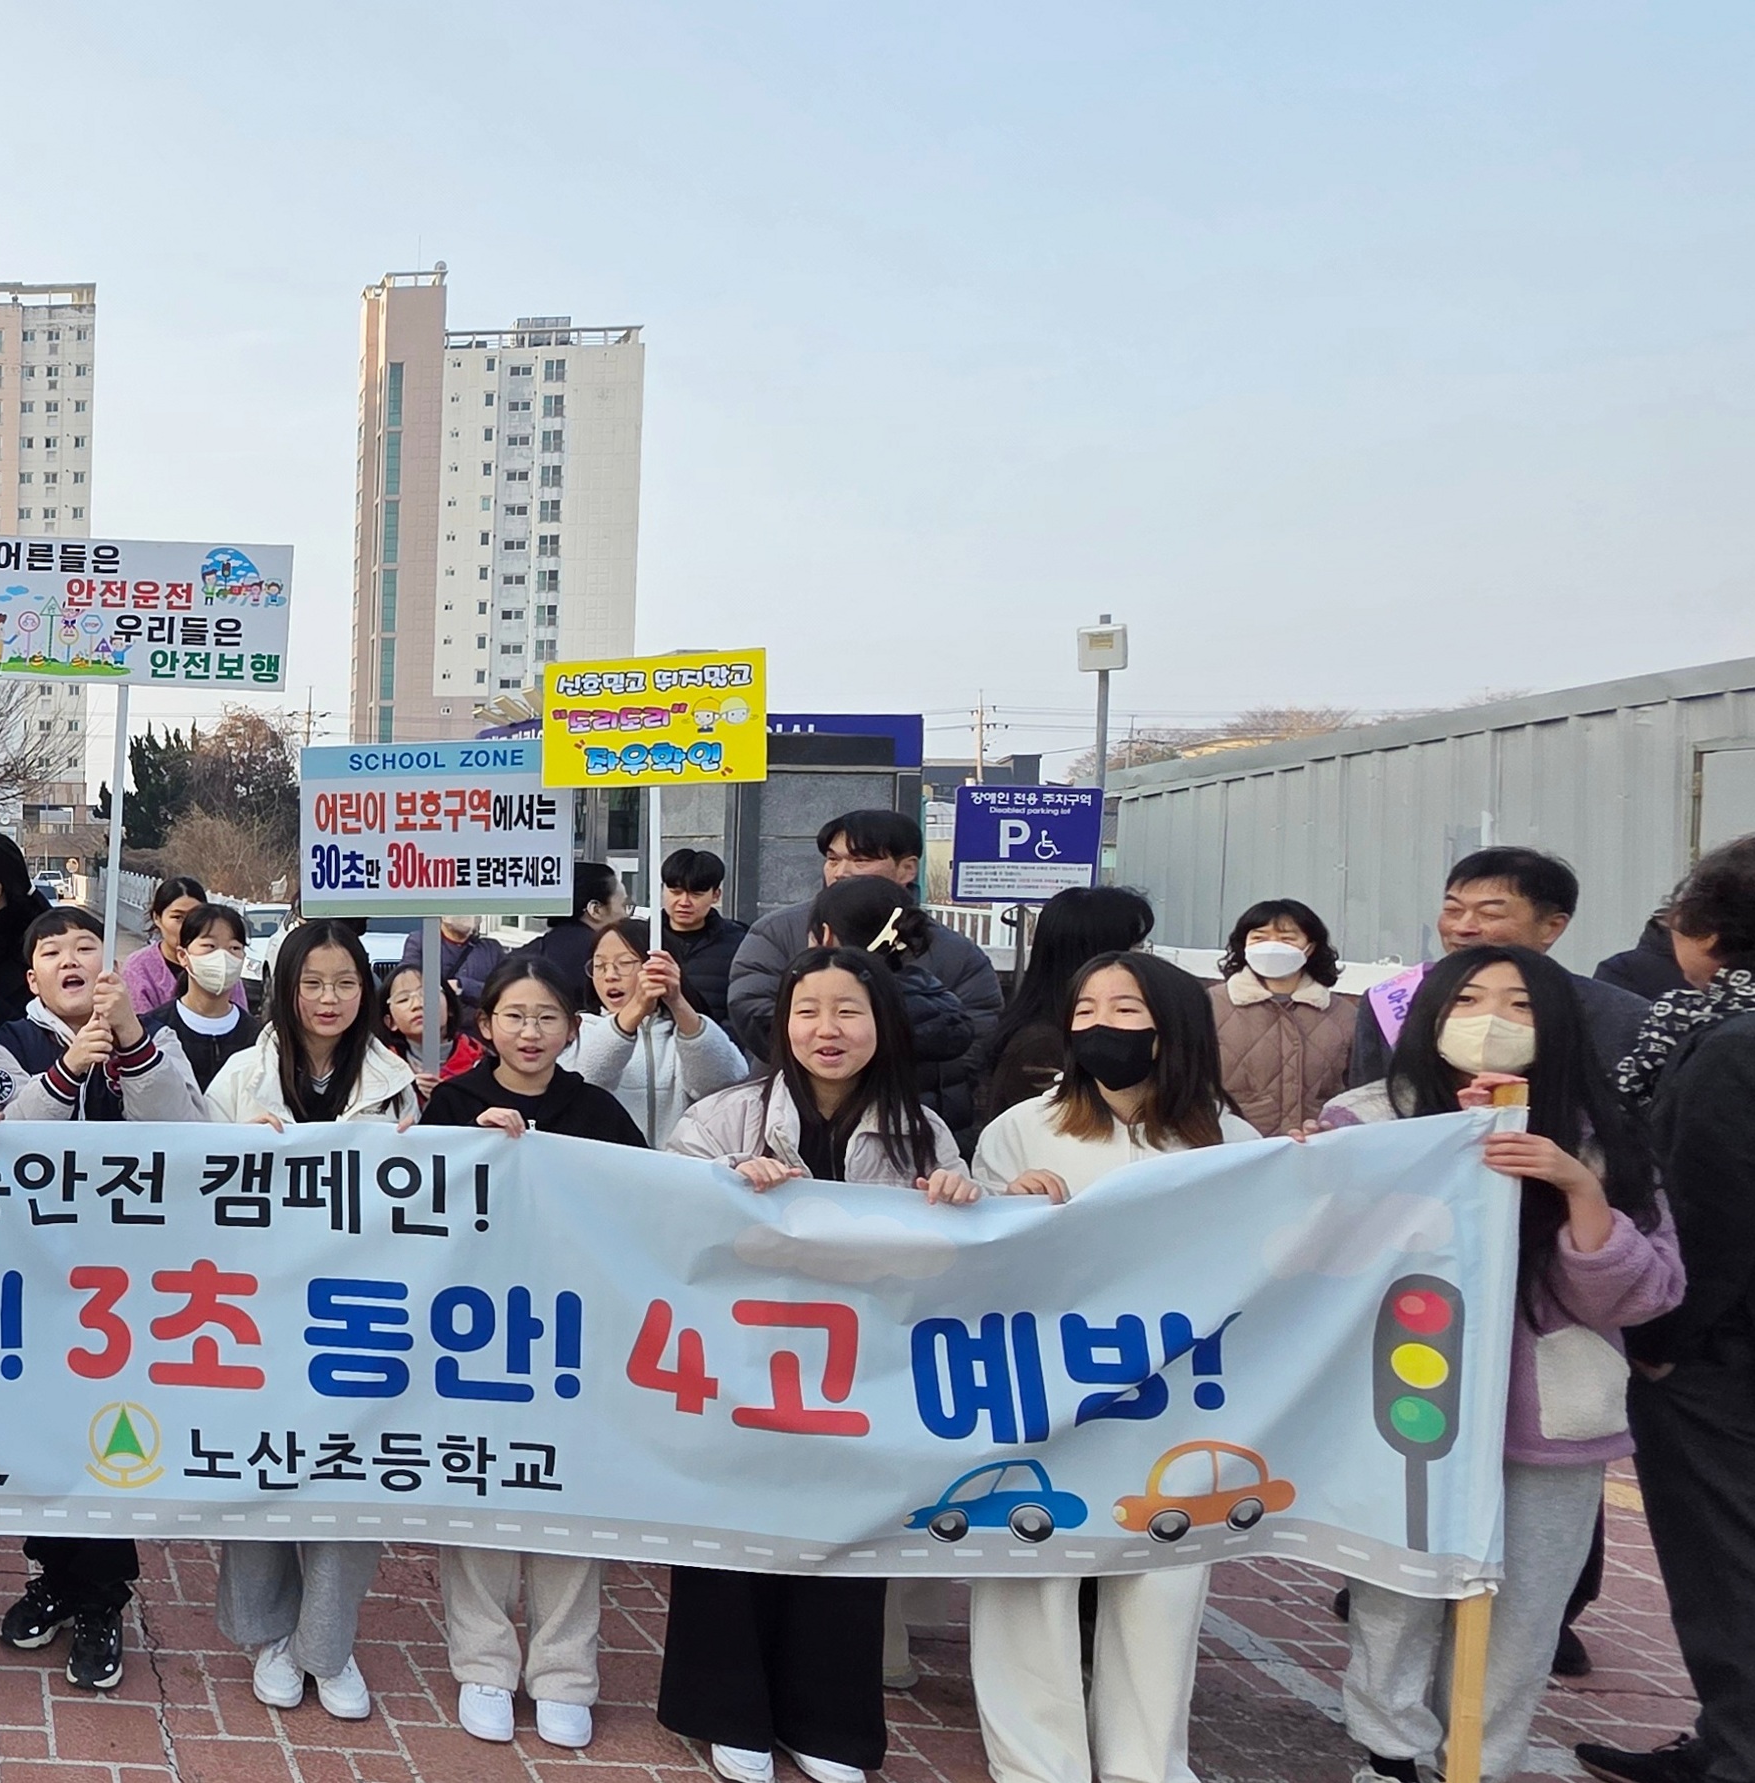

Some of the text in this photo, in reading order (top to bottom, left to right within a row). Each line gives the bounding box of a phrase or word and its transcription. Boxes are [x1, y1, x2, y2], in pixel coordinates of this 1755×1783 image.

[66, 579, 194, 610] 안전운전
[114, 614, 243, 646] 우리들은
[150, 650, 281, 683] 안전보행
[556, 671, 647, 697] 신호믿고
[349, 749, 524, 771] SCHOOL ZONE
[314, 789, 556, 835] 어린이 보호구역에서는
[970, 792, 1092, 806] 장애인 전용 주차구역
[989, 806, 1026, 814] Disabled
[1026, 807, 1059, 816] parking
[999, 819, 1031, 858] P
[311, 842, 561, 890] 30초만 30km로 달려주세요!
[199, 1149, 490, 1237] 캠페인!
[67, 1258, 266, 1391] 3초
[304, 1276, 583, 1403] 동안!
[626, 1298, 871, 1438] 4고
[182, 1427, 564, 1495] 노산초등학교
